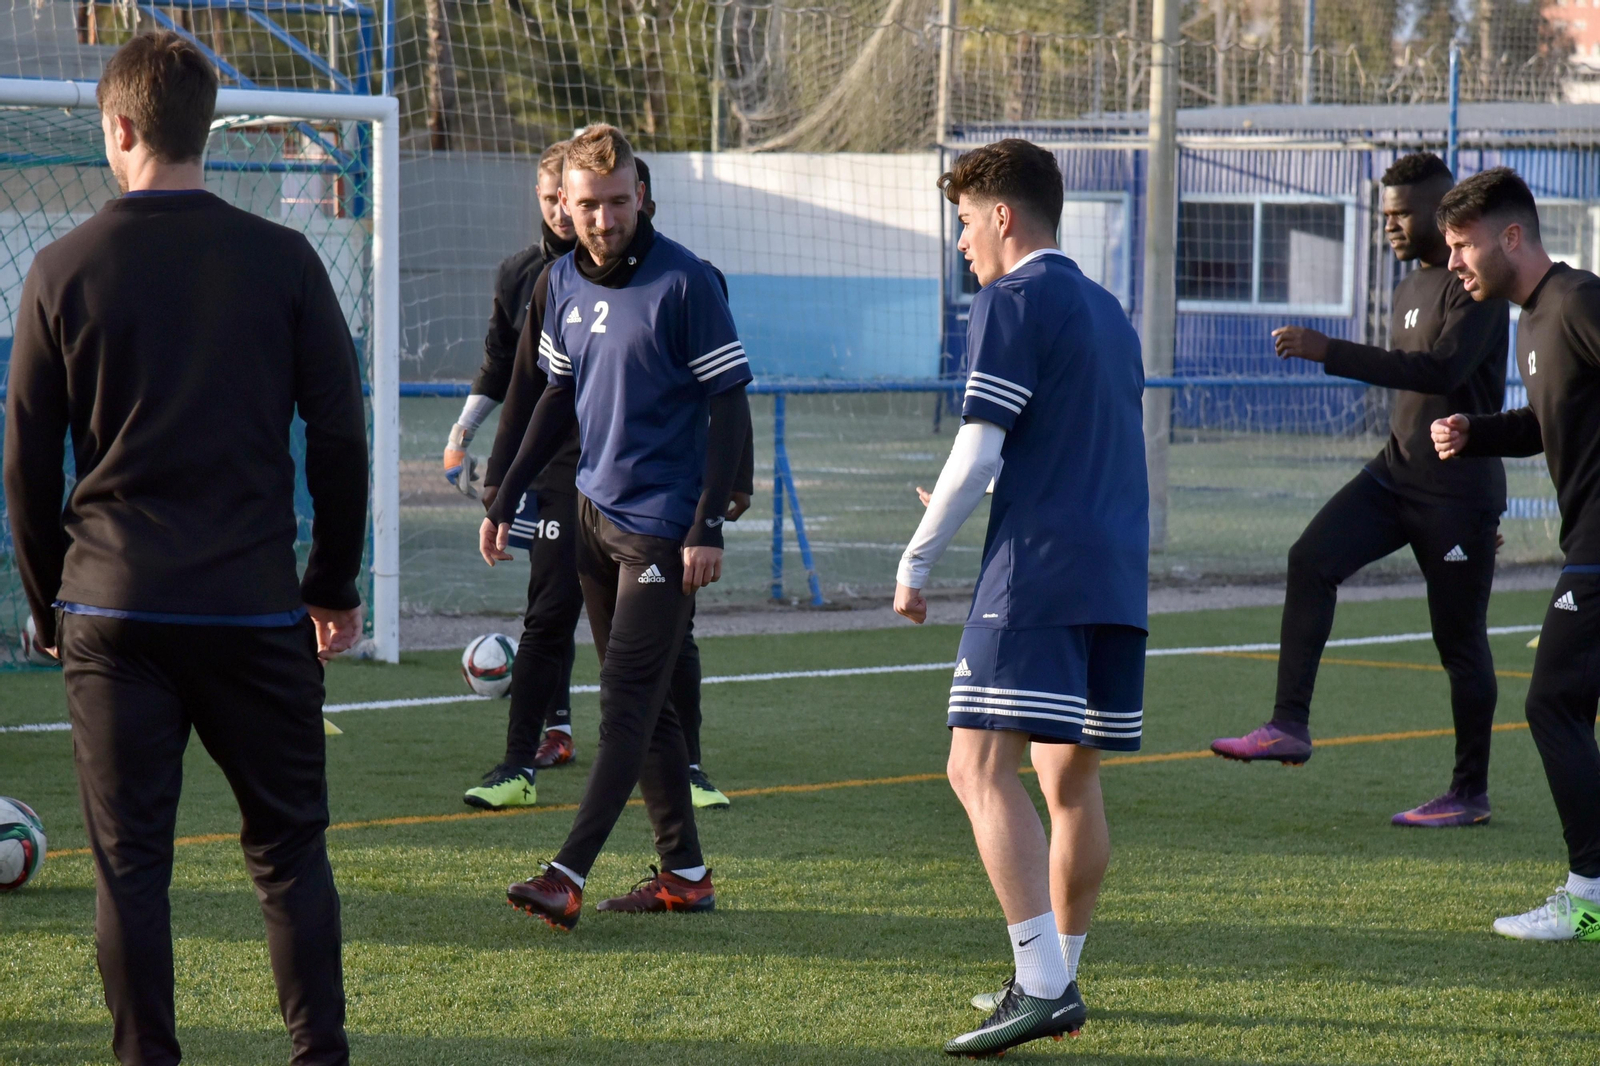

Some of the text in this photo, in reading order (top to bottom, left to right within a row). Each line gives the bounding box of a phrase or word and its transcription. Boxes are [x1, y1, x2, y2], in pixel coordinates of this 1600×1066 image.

[591, 300, 609, 334] 2
[536, 519, 561, 540] 16
[637, 575, 666, 584] adidas
[1554, 600, 1578, 612] adidas
[1051, 1001, 1080, 1020] MERCURIAL
